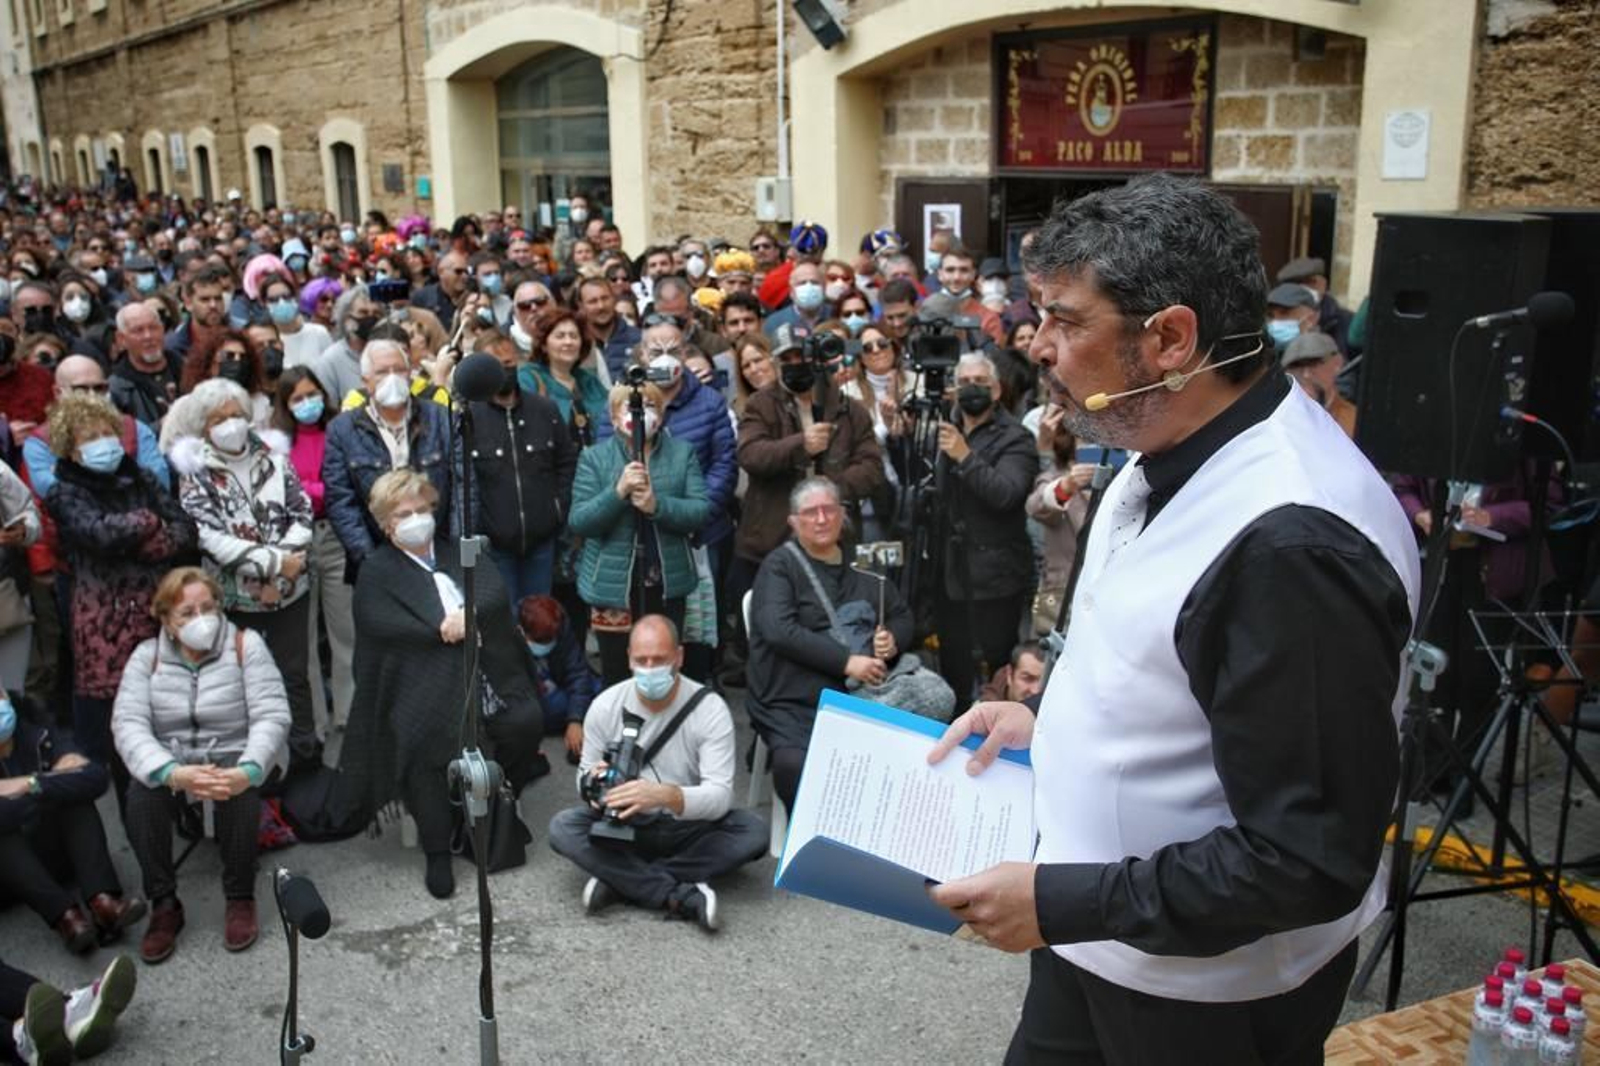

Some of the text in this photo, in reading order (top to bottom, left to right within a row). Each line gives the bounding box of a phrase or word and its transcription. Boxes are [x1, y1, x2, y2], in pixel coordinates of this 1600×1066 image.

[1089, 44, 1138, 103] ORIGINAL
[1057, 141, 1093, 161] PACO
[1103, 141, 1142, 162] ALBA
